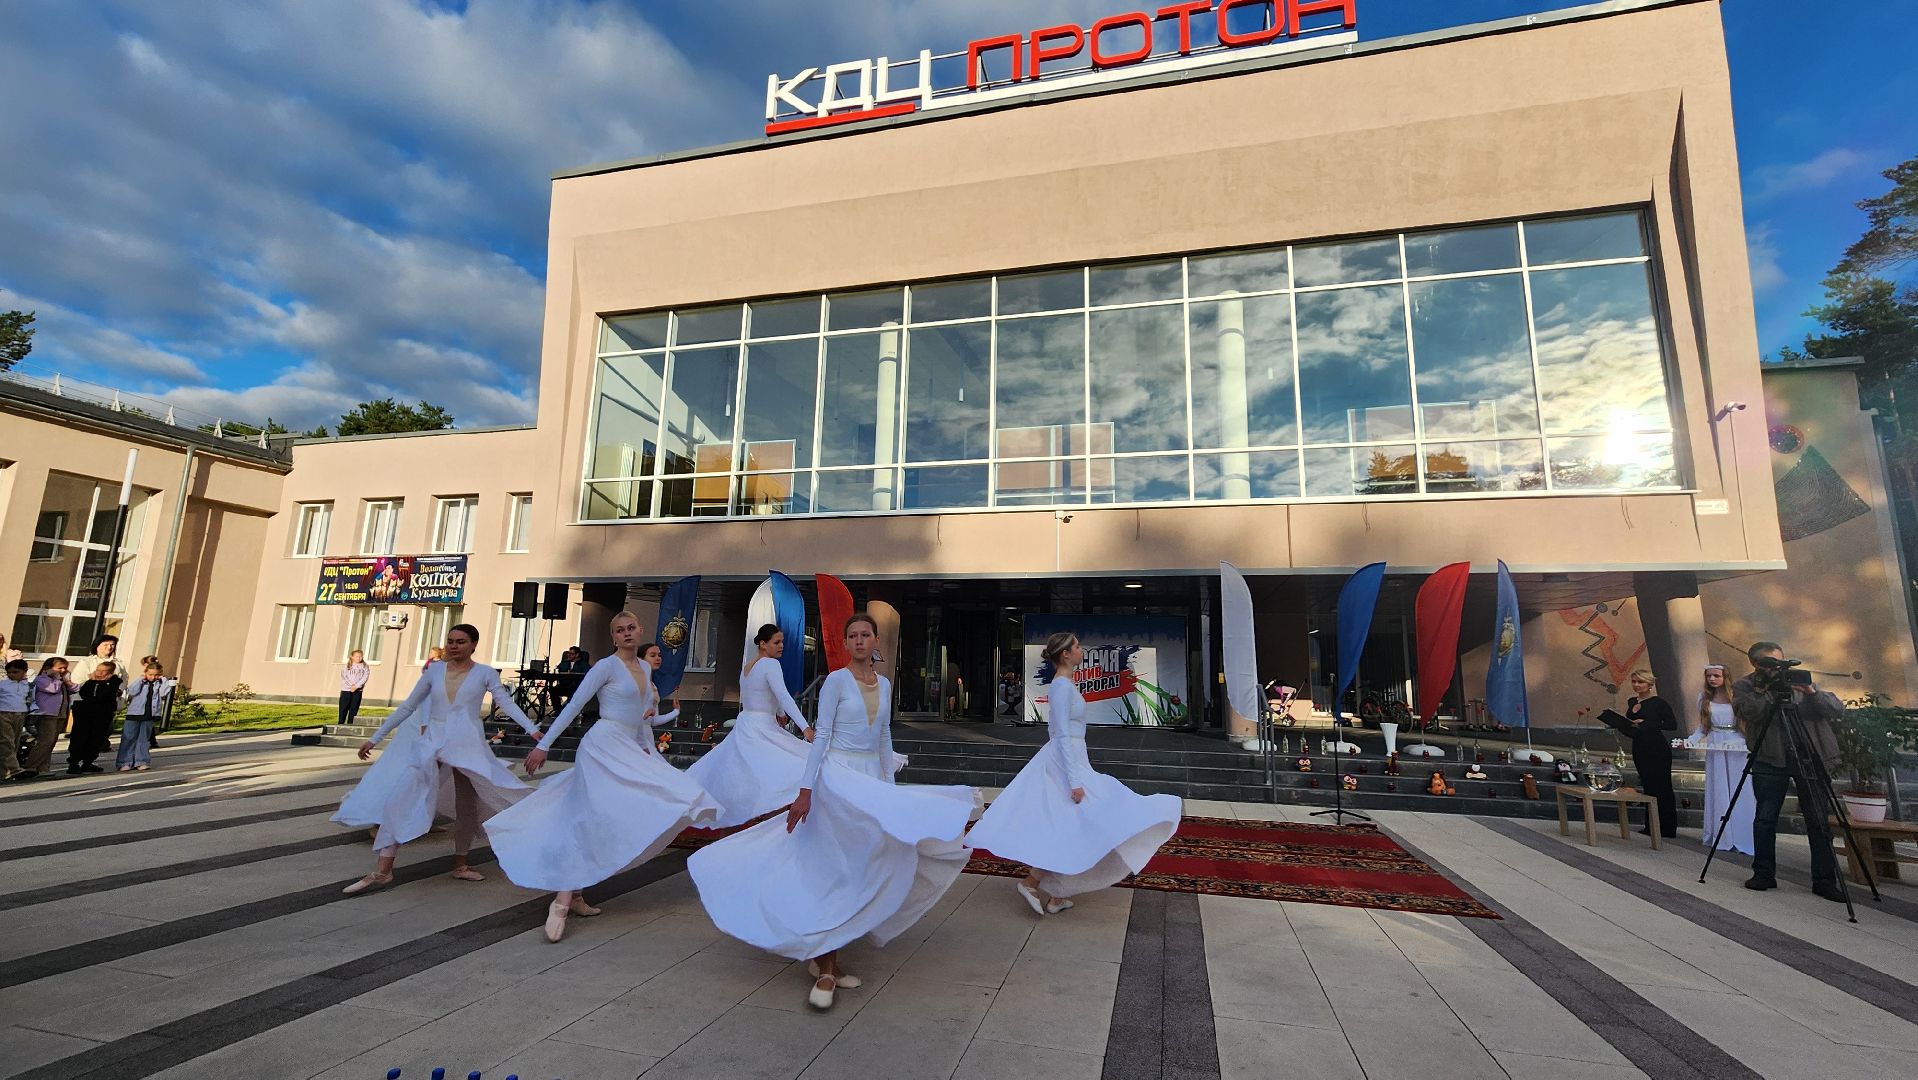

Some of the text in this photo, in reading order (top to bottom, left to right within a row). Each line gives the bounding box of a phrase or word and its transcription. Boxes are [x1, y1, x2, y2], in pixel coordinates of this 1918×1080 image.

[766, 0, 1357, 118] КДЦ ПРОТОН
[408, 573, 465, 589] КОШКИ
[317, 583, 367, 601] 27 СЕНТЯБРЯ
[411, 588, 458, 600] Куклачева
[1074, 649, 1120, 673] ССИЯ
[1073, 664, 1103, 683] ОТИВ
